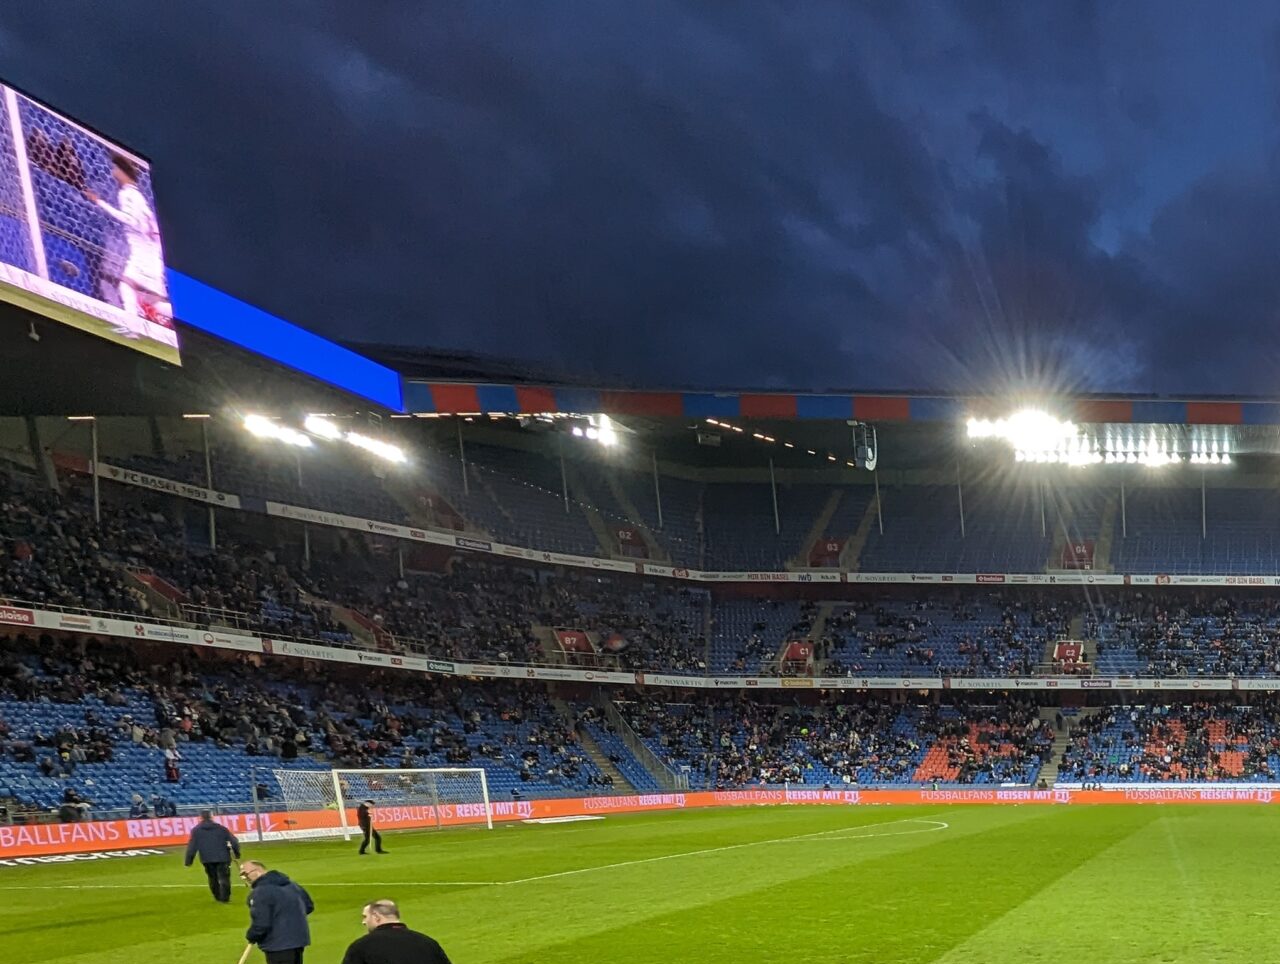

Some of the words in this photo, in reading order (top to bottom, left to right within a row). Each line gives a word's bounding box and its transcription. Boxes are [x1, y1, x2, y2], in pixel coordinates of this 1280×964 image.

[638, 794, 661, 806] REISEN
[714, 790, 781, 801] FUSSBALLFANS
[786, 790, 818, 800] REISEN
[821, 790, 841, 800] MIT
[920, 790, 994, 800] FUSSBALLFANS
[996, 789, 1029, 800] REISEN
[1032, 790, 1052, 800] MIT
[1125, 790, 1197, 801] FUSSBALLFANS
[1200, 790, 1231, 800] REISEN
[1235, 790, 1254, 800] MIT
[371, 804, 453, 822] USSBALLFANS
[495, 801, 514, 816] MIT
